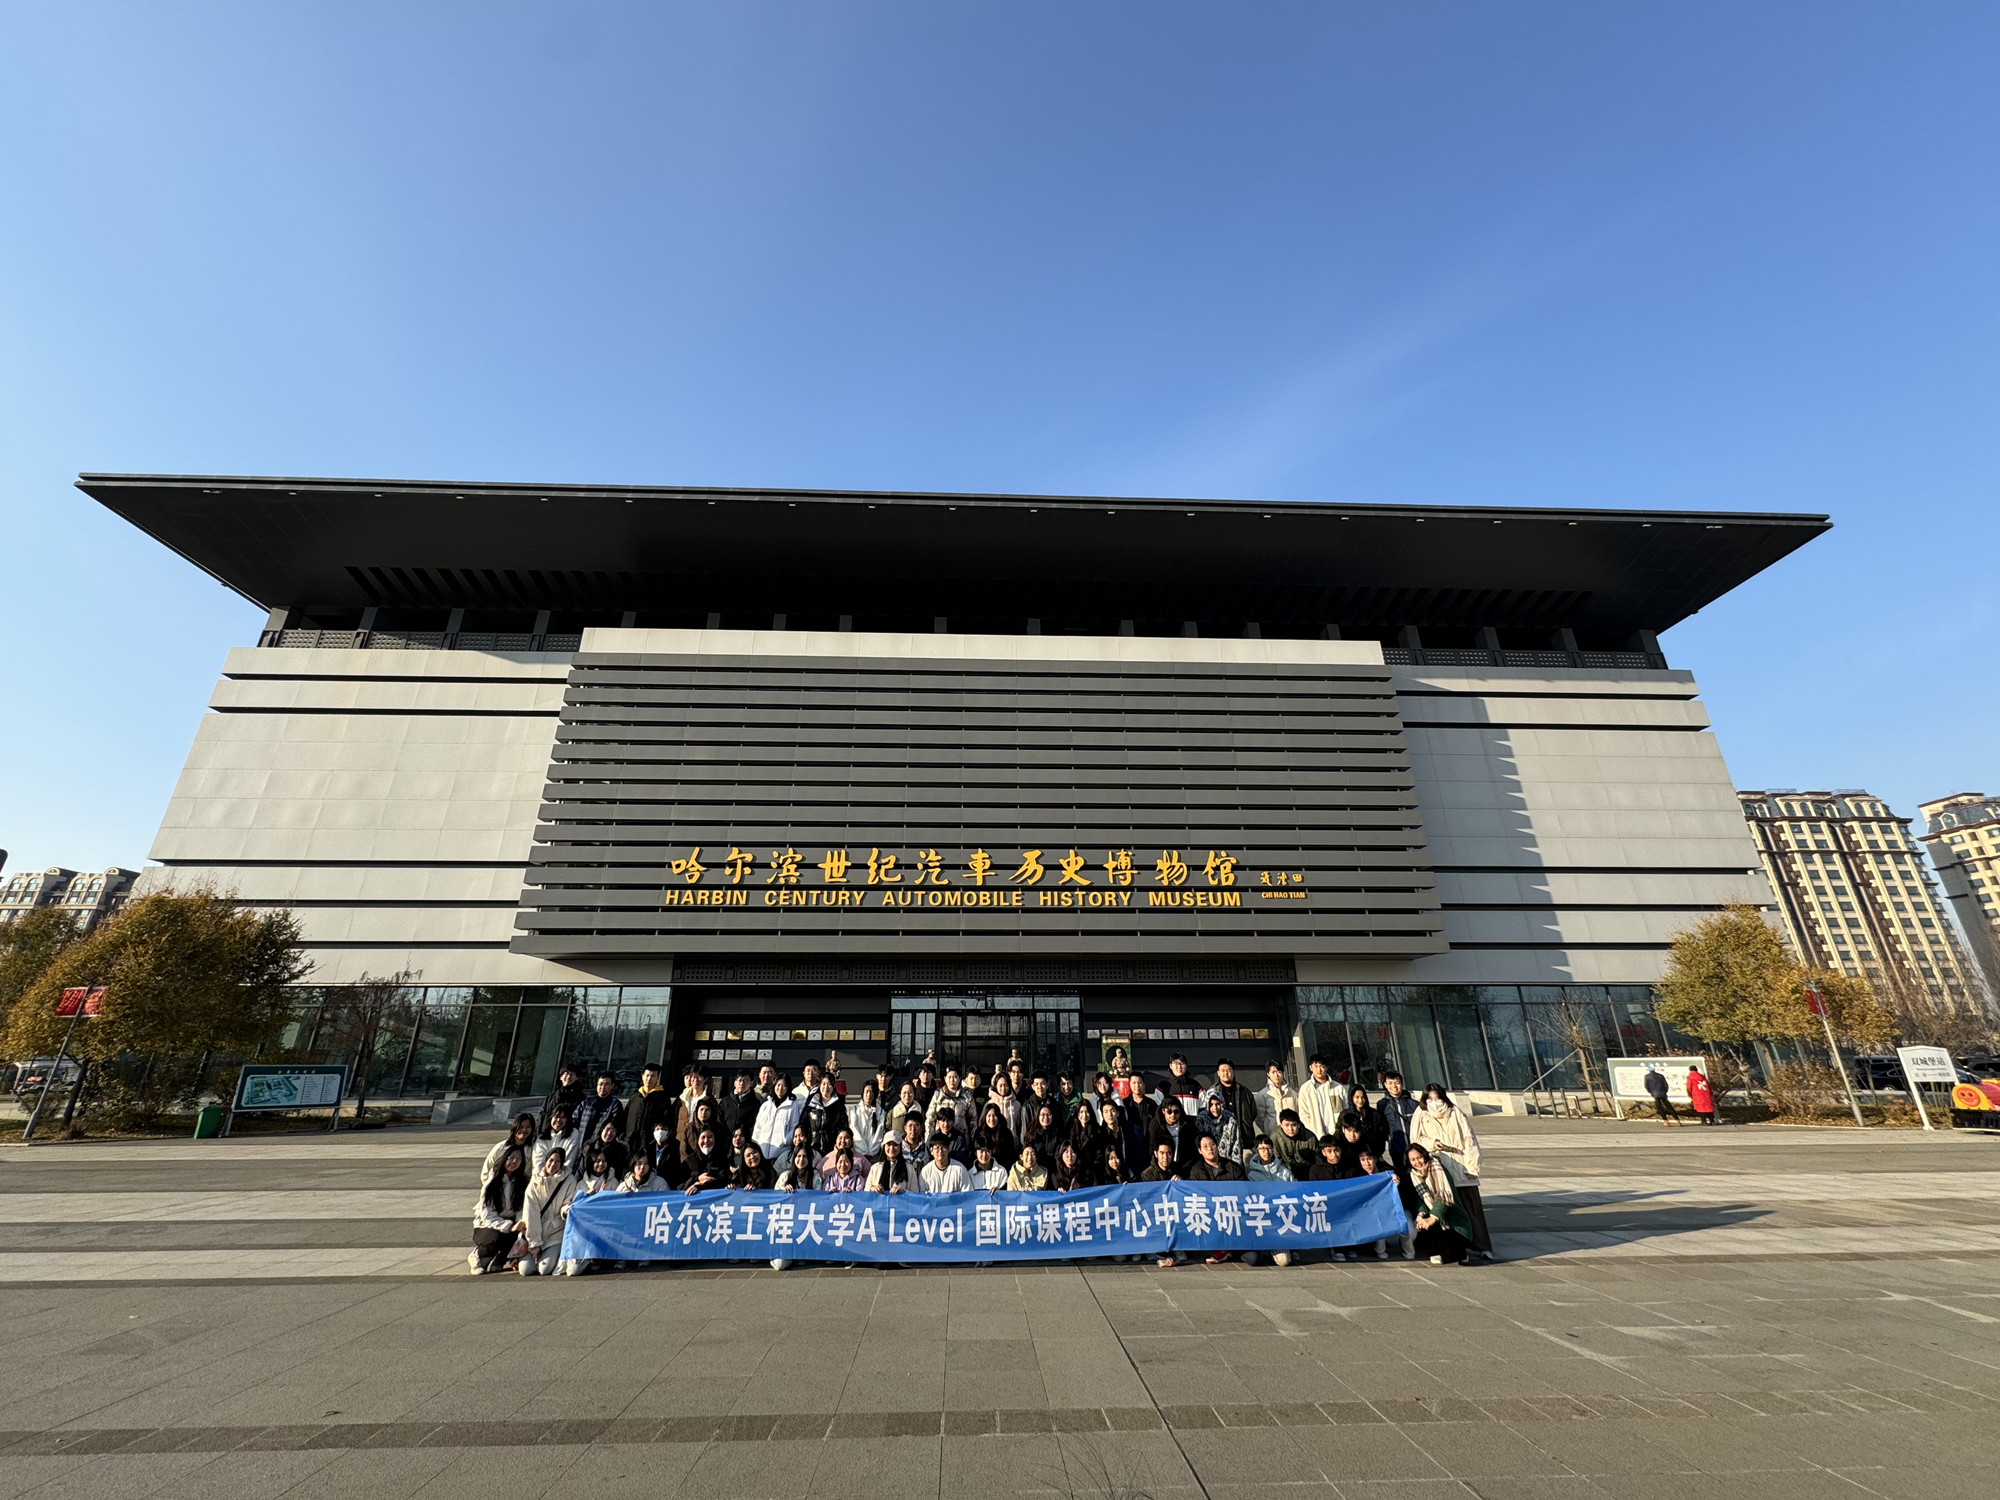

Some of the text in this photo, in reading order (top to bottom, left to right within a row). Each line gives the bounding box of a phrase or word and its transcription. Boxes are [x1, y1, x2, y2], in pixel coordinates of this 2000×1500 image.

[665, 889, 1241, 907] HARBIN CENTURY AUTOMOBILE HISTORY MUSEUM
[1261, 891, 1273, 899] CHI
[1289, 891, 1306, 899] TIAN
[888, 1207, 963, 1243] Level
[974, 1191, 1332, 1247] 国际课程中心中泰研学交流
